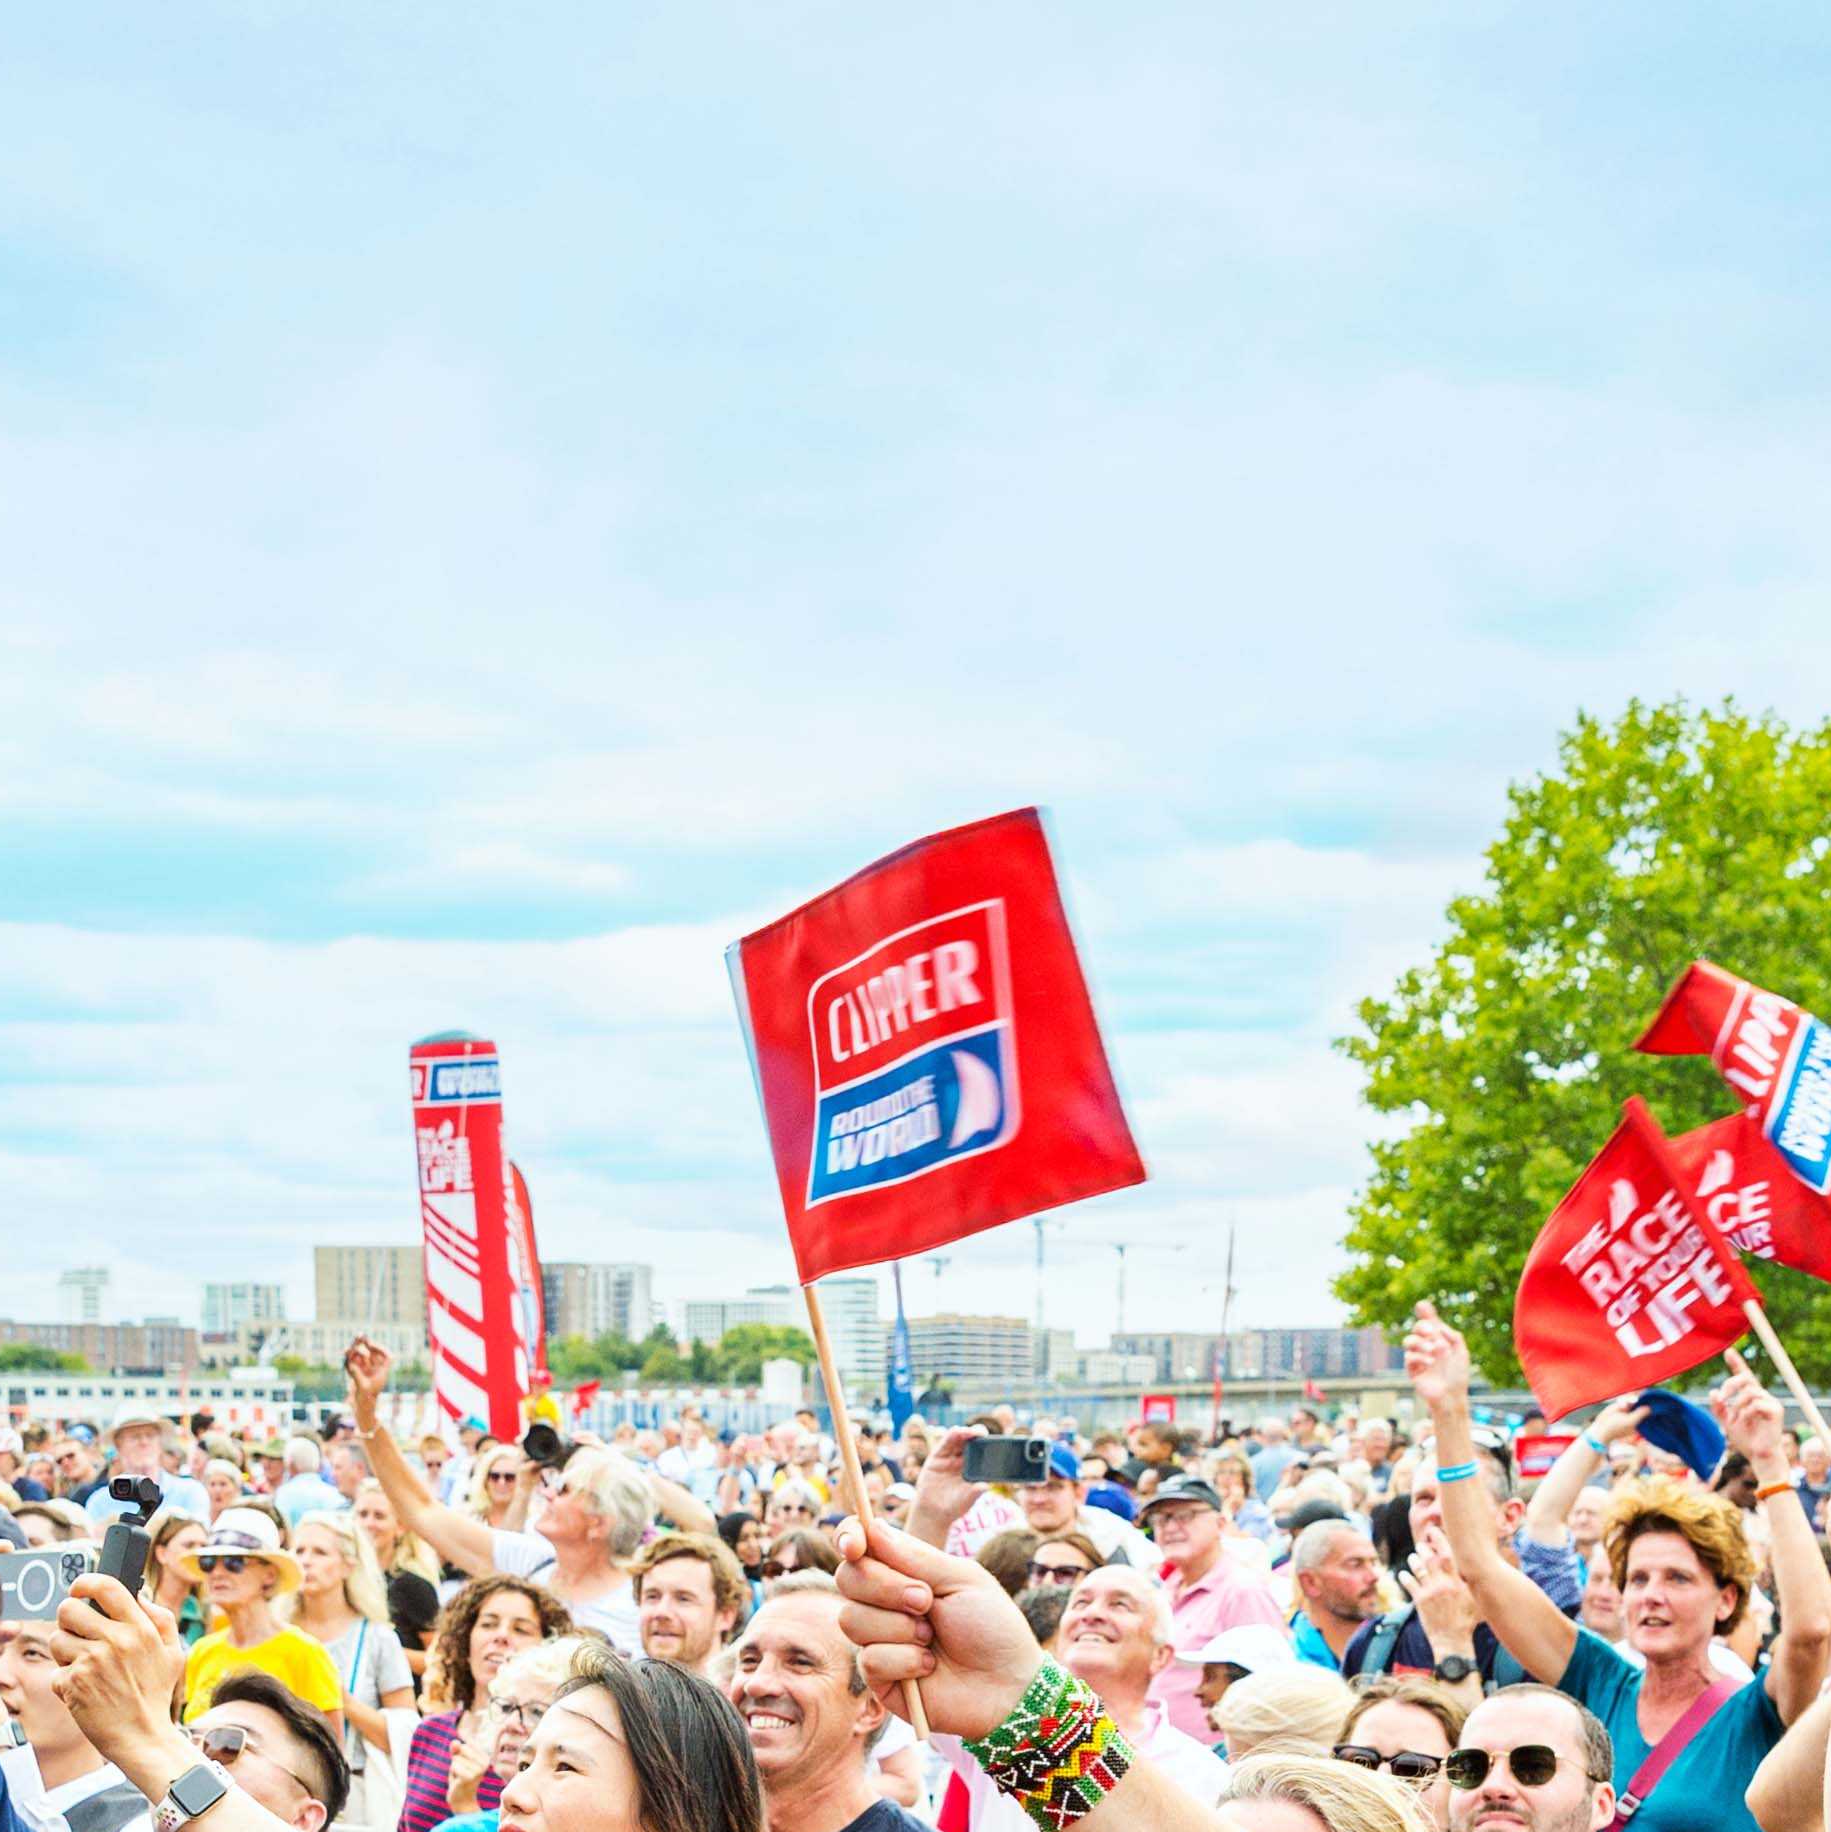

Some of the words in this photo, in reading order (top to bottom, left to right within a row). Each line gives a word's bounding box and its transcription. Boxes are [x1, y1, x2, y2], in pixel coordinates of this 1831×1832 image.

[828, 939, 985, 1063] CLIPPER
[827, 1103, 942, 1175] WORLD
[1561, 1219, 1614, 1275] THE
[1579, 1188, 1694, 1309] RACE
[1708, 1181, 1772, 1233] CE
[1606, 1283, 1642, 1328] OF
[1638, 1224, 1706, 1292] YOUR
[1615, 1247, 1734, 1358] LIFE
